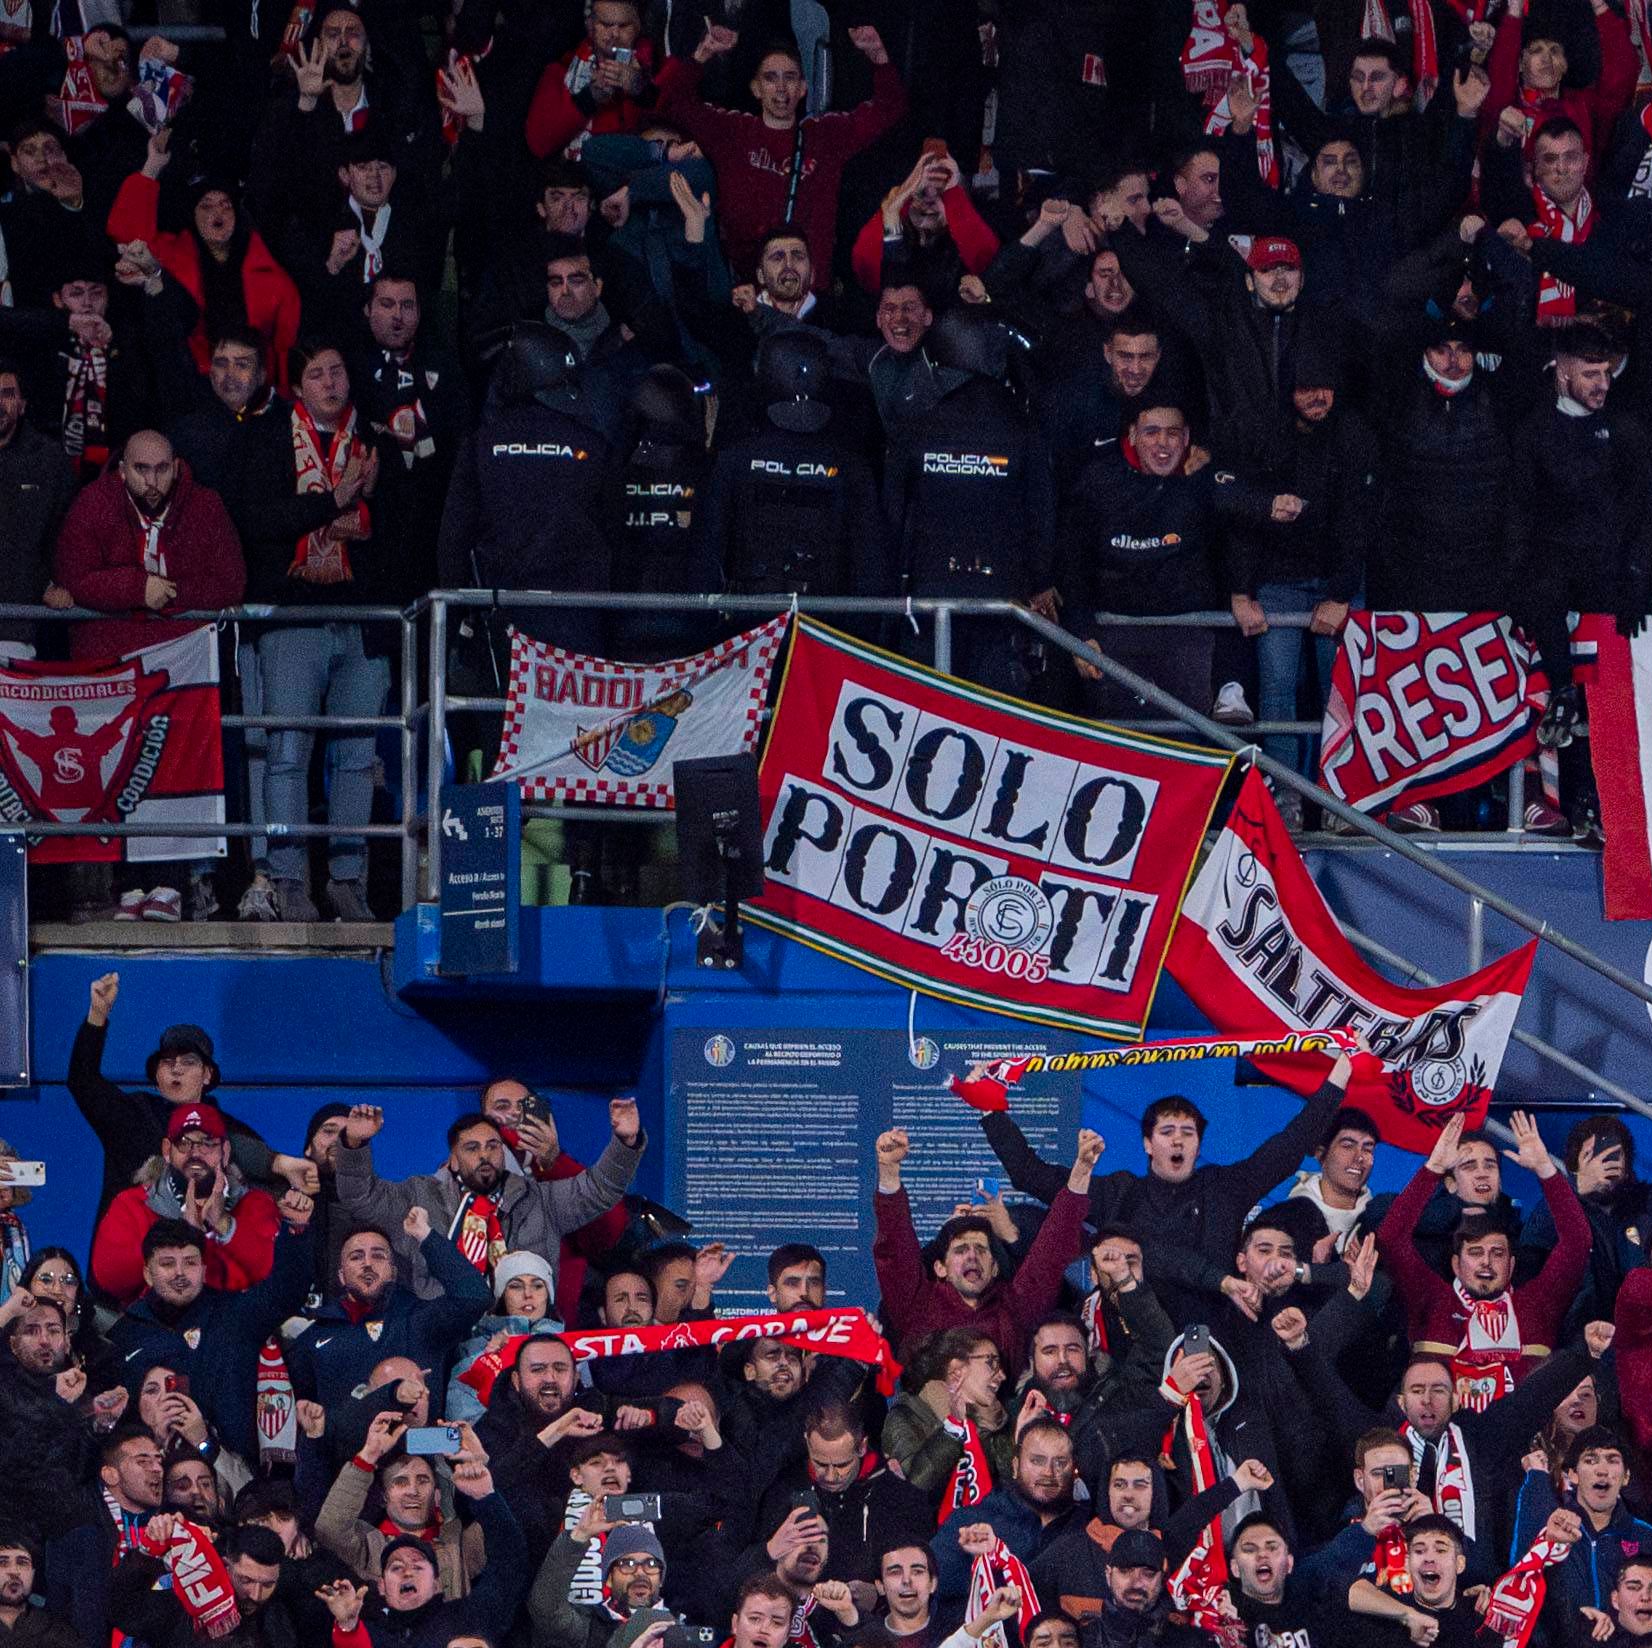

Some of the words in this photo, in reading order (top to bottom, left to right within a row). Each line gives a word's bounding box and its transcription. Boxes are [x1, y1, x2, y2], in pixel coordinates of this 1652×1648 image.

[494, 444, 573, 457] POLICIA
[924, 453, 992, 465] POLICIA
[751, 460, 827, 475] POLCIA
[923, 463, 1008, 476] NACIONAL
[832, 696, 1147, 875] SOLO
